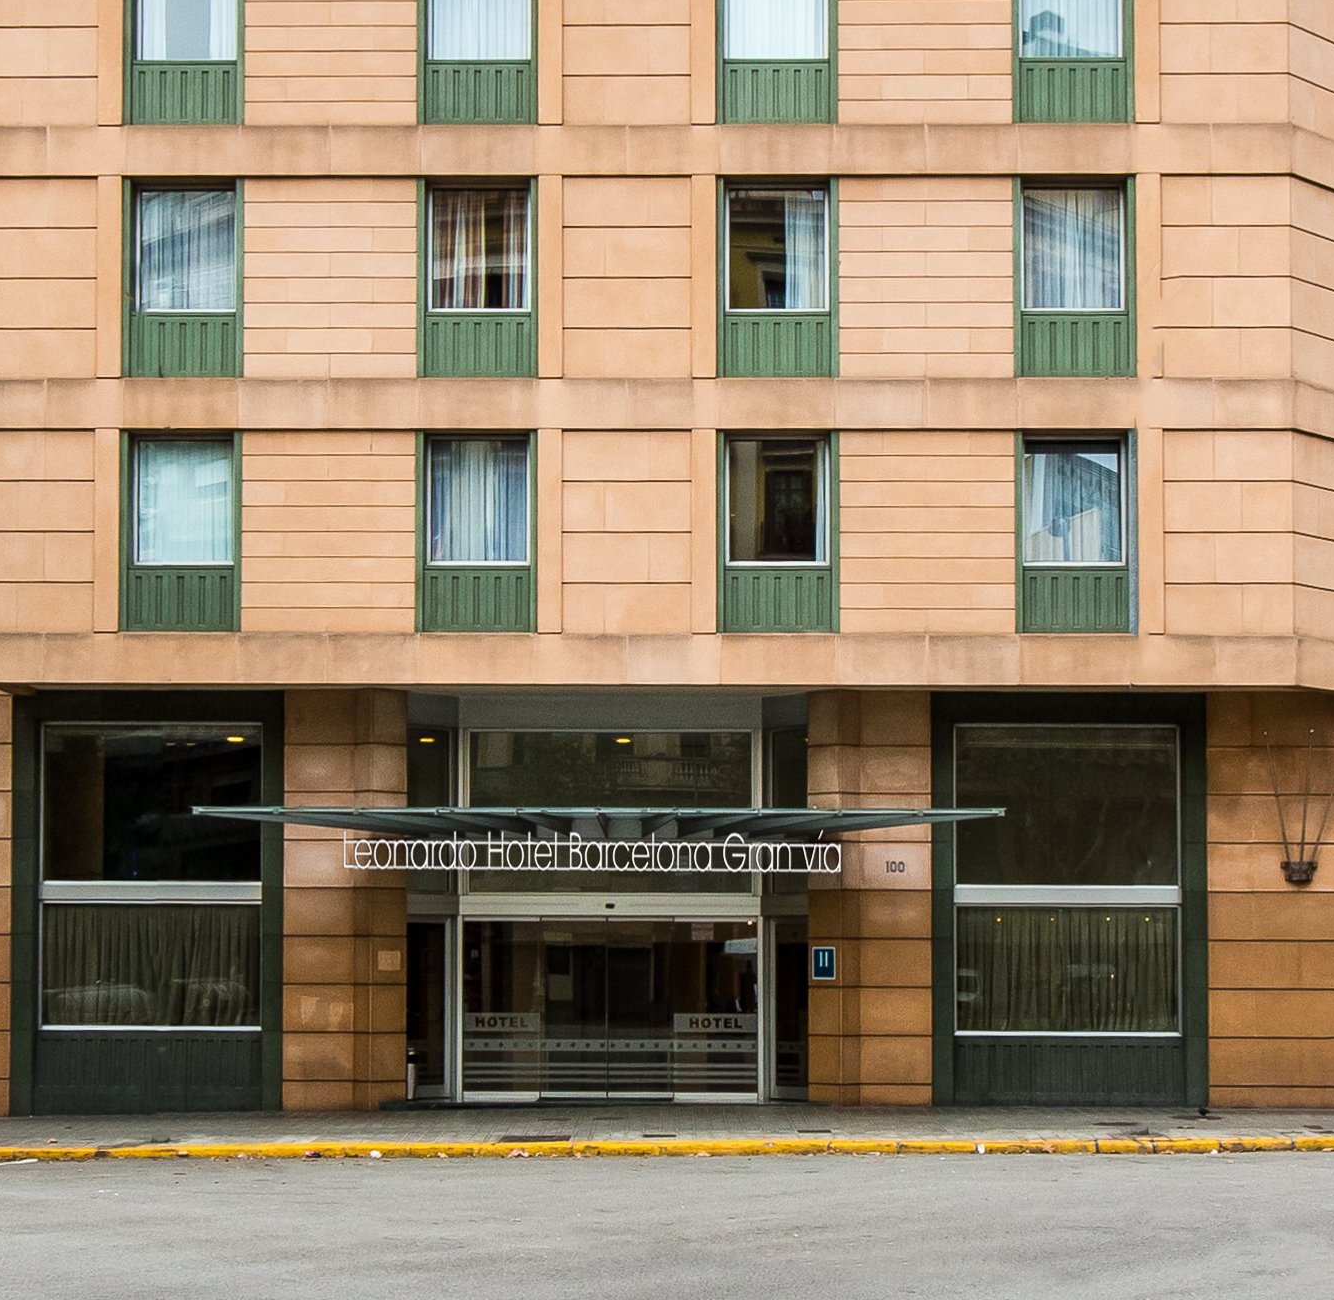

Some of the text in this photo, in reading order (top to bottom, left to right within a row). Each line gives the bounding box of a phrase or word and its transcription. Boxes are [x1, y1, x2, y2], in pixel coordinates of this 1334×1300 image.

[343, 829, 842, 873] Leonardo Hotel Barcelona Gran vía
[885, 861, 905, 873] 100
[474, 1016, 529, 1029] HOTEL
[688, 1017, 743, 1030] HOTEL
